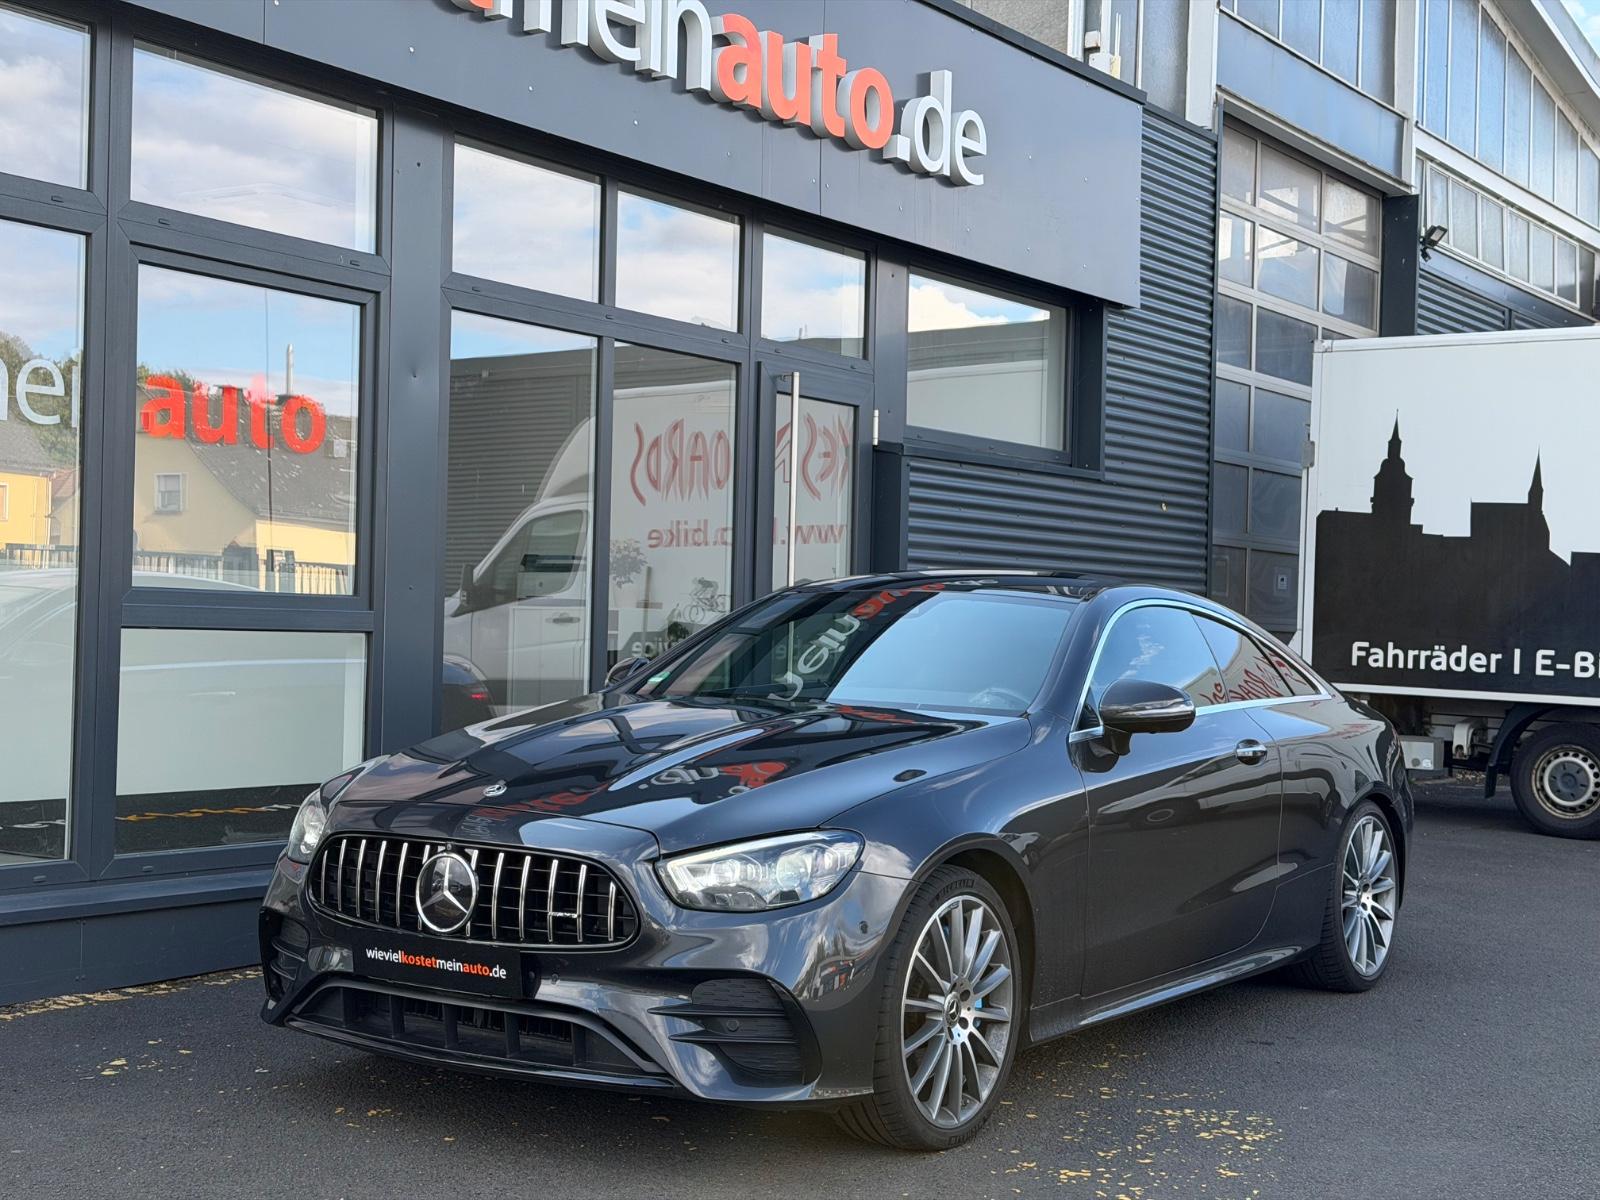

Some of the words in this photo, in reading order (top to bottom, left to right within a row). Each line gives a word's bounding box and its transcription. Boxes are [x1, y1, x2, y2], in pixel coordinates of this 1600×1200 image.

[455, 0, 988, 187] einauto.de
[1351, 640, 1503, 674] Fahrräder
[365, 947, 507, 980] wievielkostetmeinauto.de
